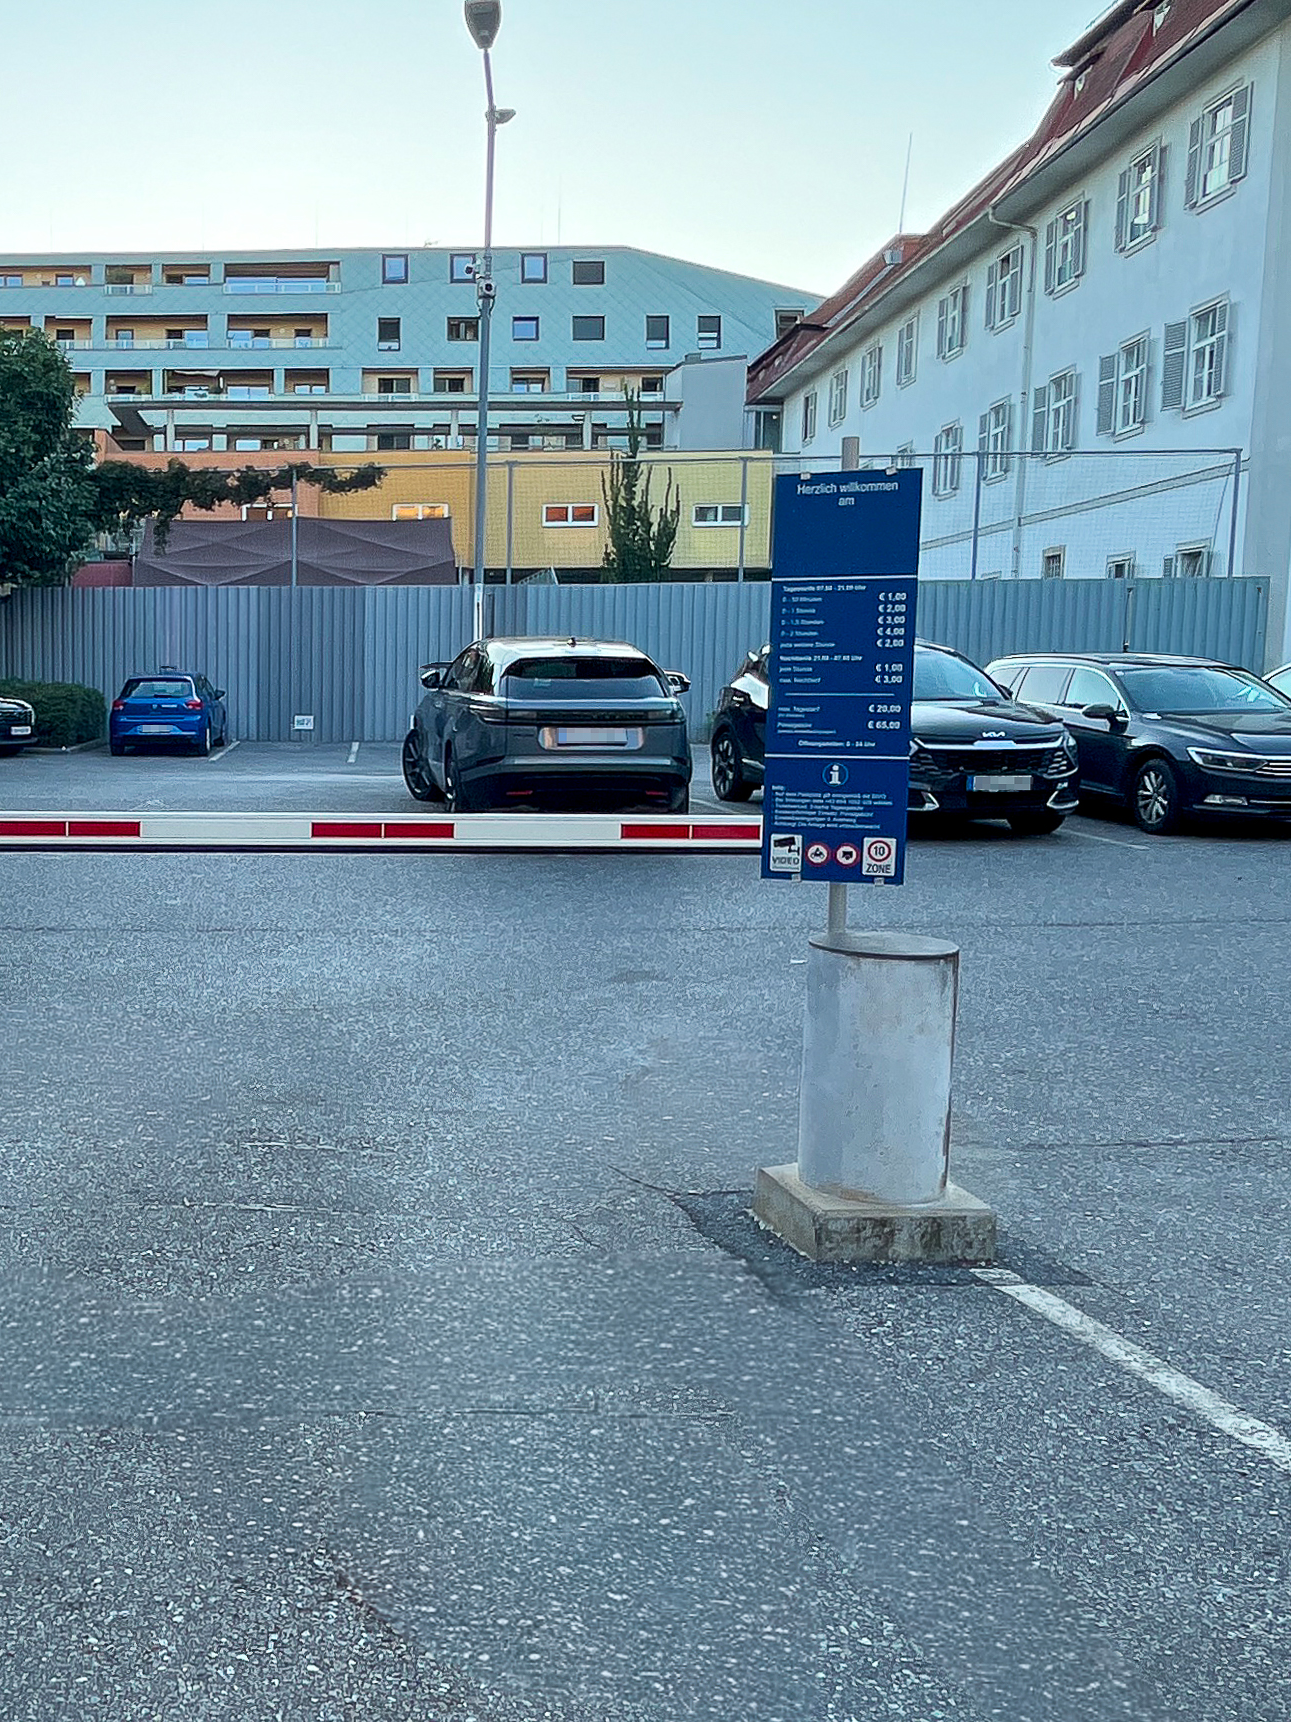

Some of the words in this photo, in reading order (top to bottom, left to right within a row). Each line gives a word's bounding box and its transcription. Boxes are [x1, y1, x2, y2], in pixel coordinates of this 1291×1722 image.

[797, 483, 837, 495] Herzlich
[839, 481, 898, 493] willkommen
[838, 497, 855, 506] am
[878, 592, 885, 600] €
[888, 592, 907, 601] 1,00
[878, 604, 884, 612] €
[886, 604, 906, 613] 2,00
[878, 616, 884, 624] €
[886, 616, 906, 625] 3,00
[877, 628, 883, 636] €
[885, 627, 905, 636] 4,00
[876, 640, 882, 648] €
[885, 639, 904, 648] 2,00
[876, 664, 882, 672] €
[884, 664, 903, 672] 1,00
[874, 676, 880, 684] €
[884, 676, 903, 684] 3,00
[868, 704, 874, 712] €
[876, 704, 902, 714] 20,00
[868, 721, 874, 729] €
[876, 721, 900, 730] 65,00
[873, 846, 886, 856] 10
[772, 856, 799, 865] VIDEO
[866, 864, 891, 874] ZONE
